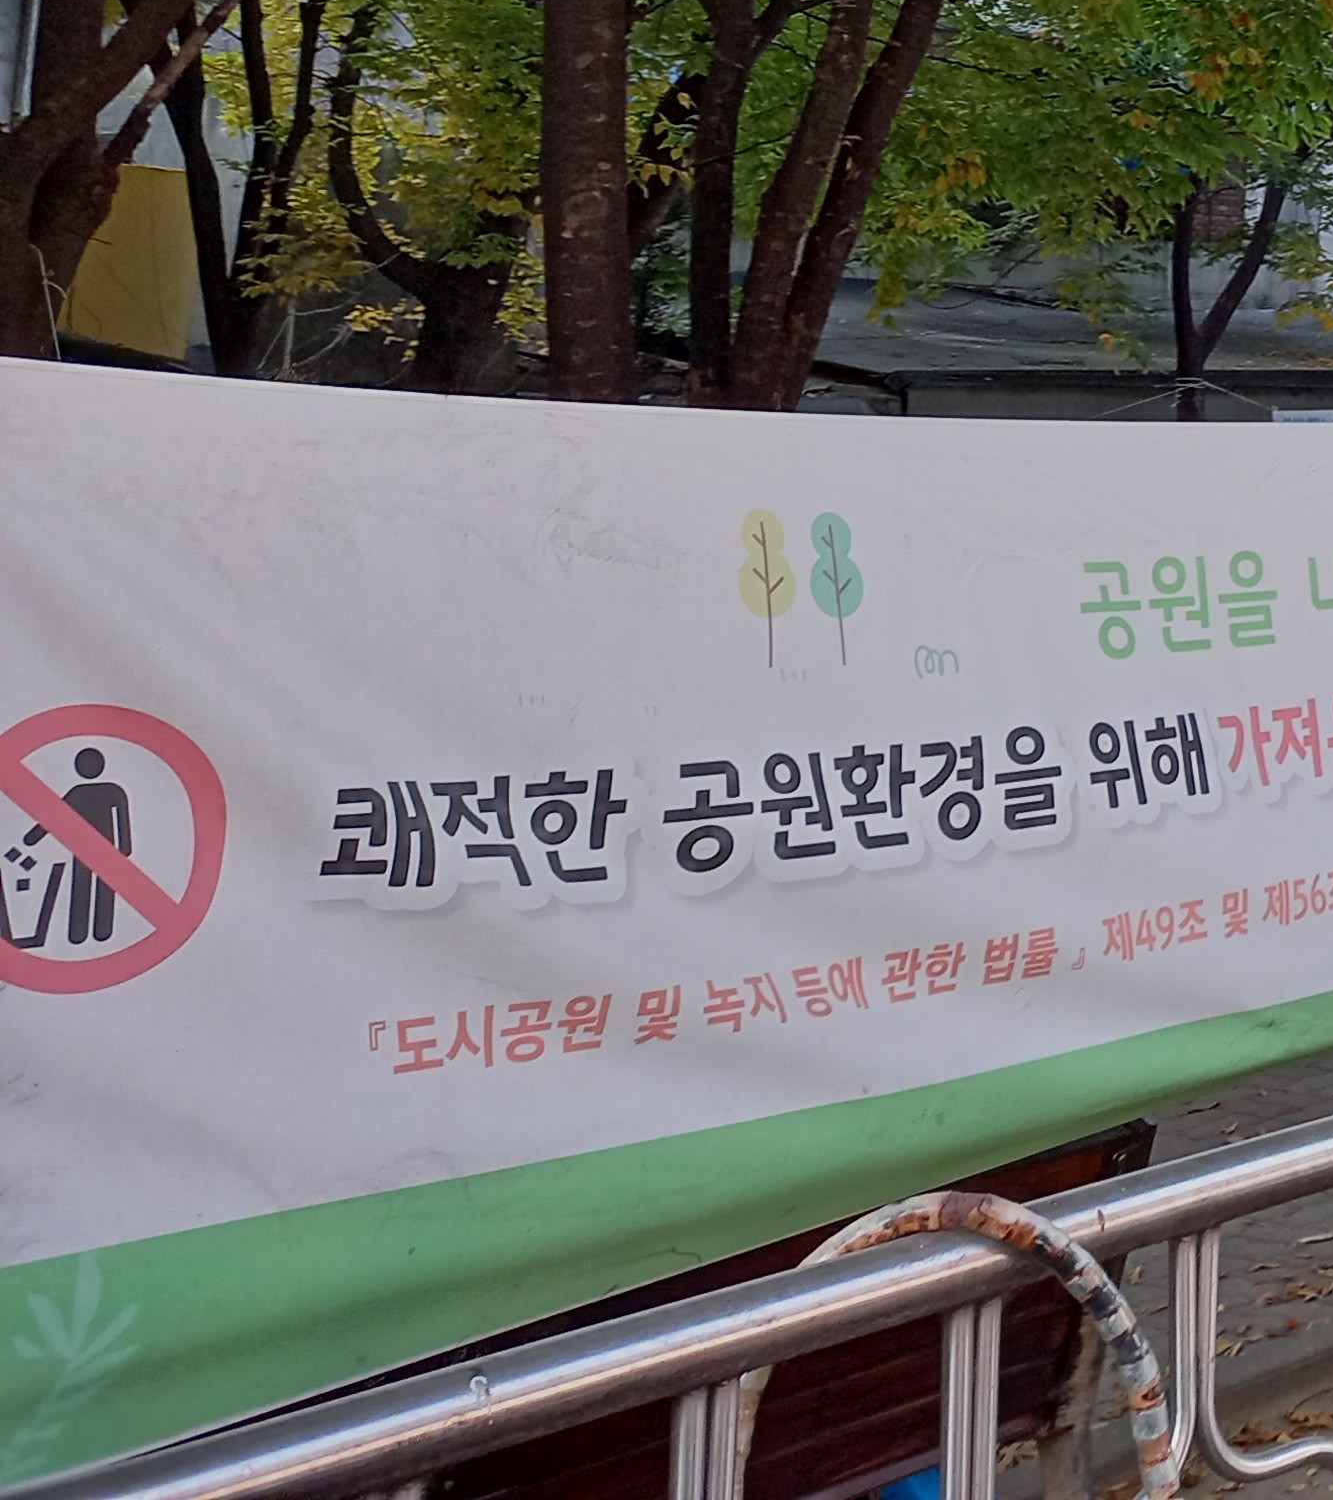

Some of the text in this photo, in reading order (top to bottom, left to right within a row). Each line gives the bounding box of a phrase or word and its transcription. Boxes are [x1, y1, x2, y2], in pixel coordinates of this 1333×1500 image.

[1080, 550, 1278, 660] 공원을
[319, 768, 628, 887] 쾌적한
[663, 725, 1062, 873] 공원환경을
[1089, 712, 1210, 809] 위해
[633, 984, 682, 1045] 및
[703, 972, 788, 1033] 녹지
[791, 956, 870, 1018] 등에
[881, 941, 967, 1003] 관한
[1102, 899, 1208, 962] 제49조
[1221, 887, 1249, 940] 및
